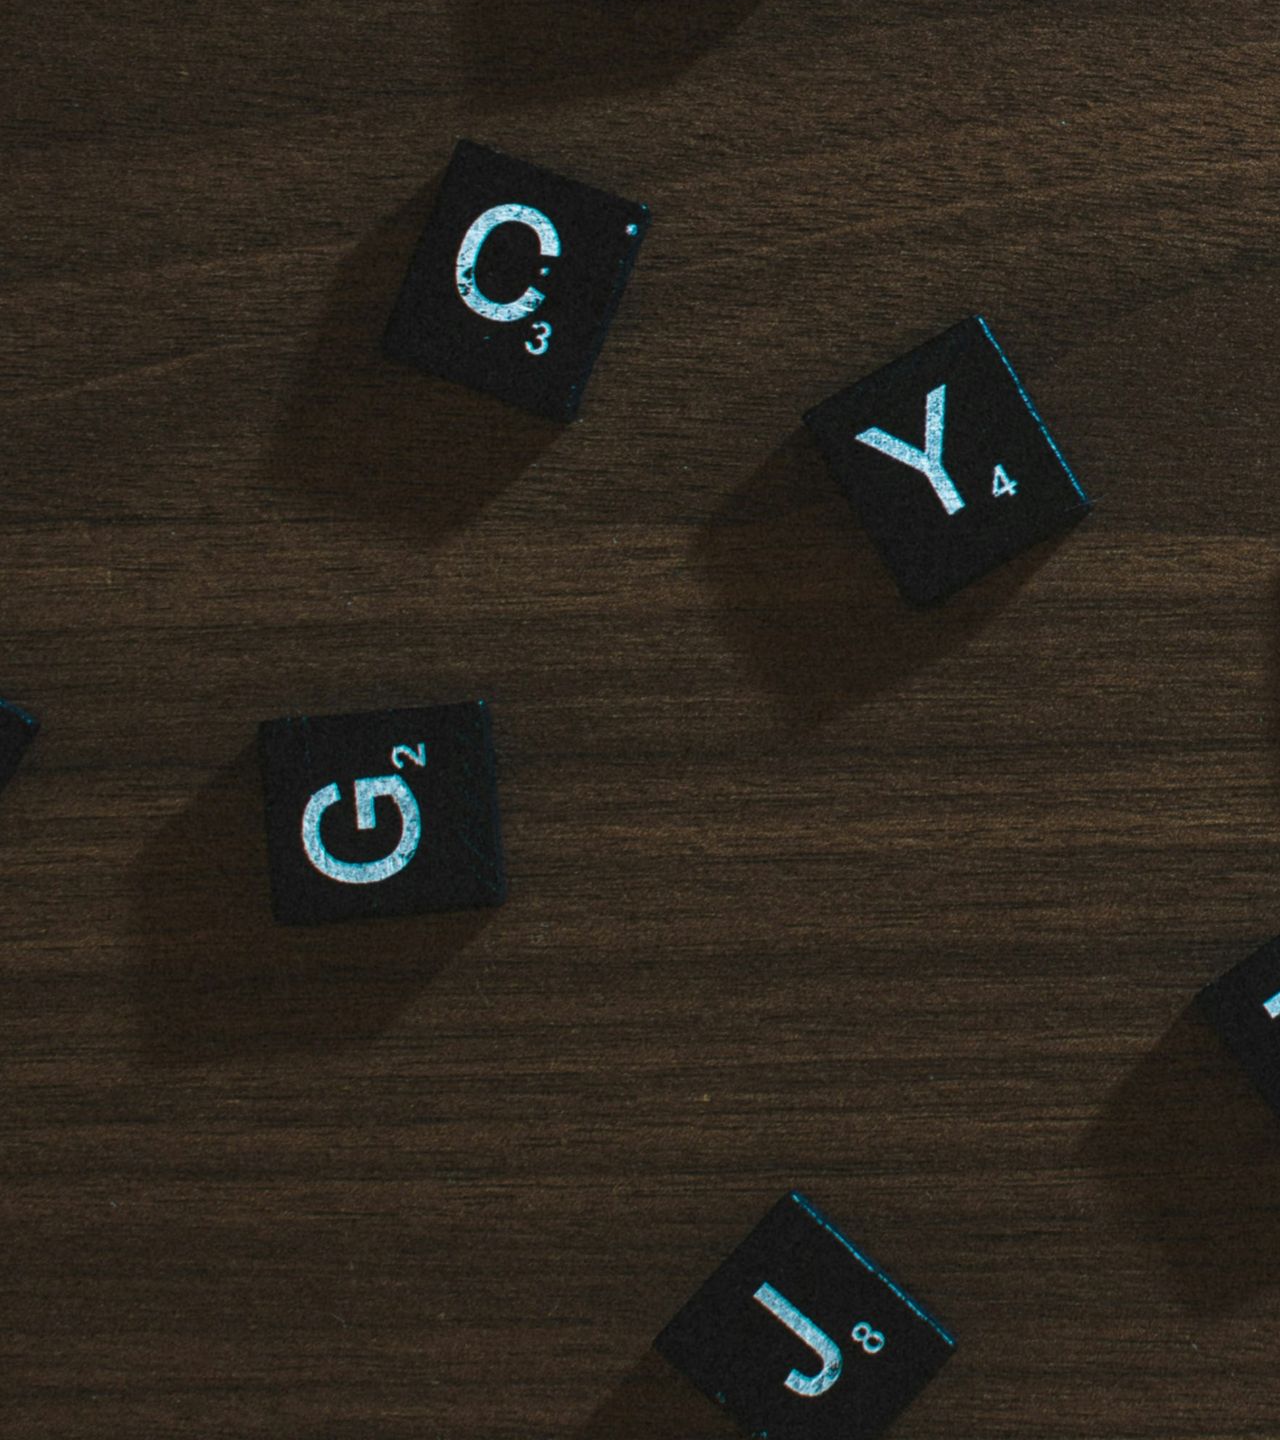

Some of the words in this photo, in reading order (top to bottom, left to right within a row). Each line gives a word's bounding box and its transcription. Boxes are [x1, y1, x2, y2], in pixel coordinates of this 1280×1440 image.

[455, 204, 558, 321] C
[525, 323, 549, 355] 3
[855, 385, 963, 515] Y
[992, 466, 1015, 497] 4
[392, 745, 424, 768] 2
[302, 777, 418, 884] G
[754, 1283, 839, 1397] J
[852, 1323, 882, 1353] 8
